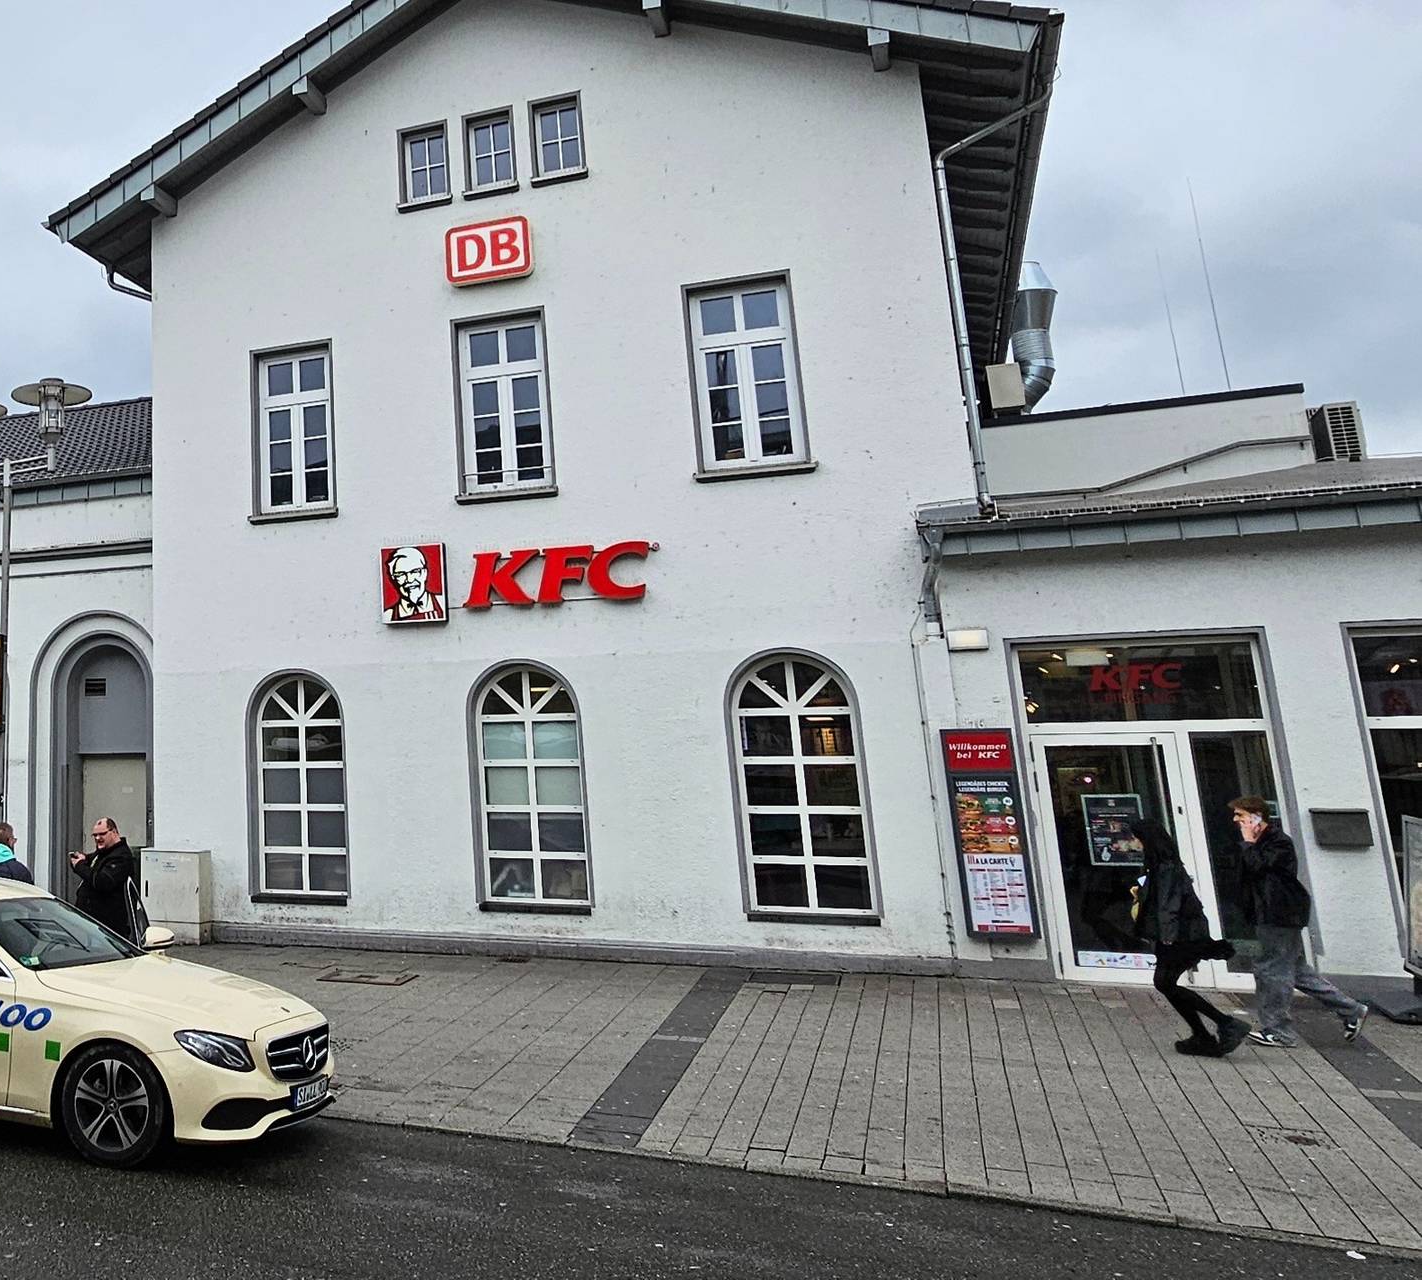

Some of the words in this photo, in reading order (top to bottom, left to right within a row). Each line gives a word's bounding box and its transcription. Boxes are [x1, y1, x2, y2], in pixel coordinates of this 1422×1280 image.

[456, 226, 521, 273] DB
[462, 540, 650, 610] KFC
[1089, 661, 1184, 692] KFC
[948, 743, 1007, 751] Willkommen
[977, 751, 1000, 759] KFC
[980, 857, 988, 865] LA
[989, 857, 1009, 865] CARTE
